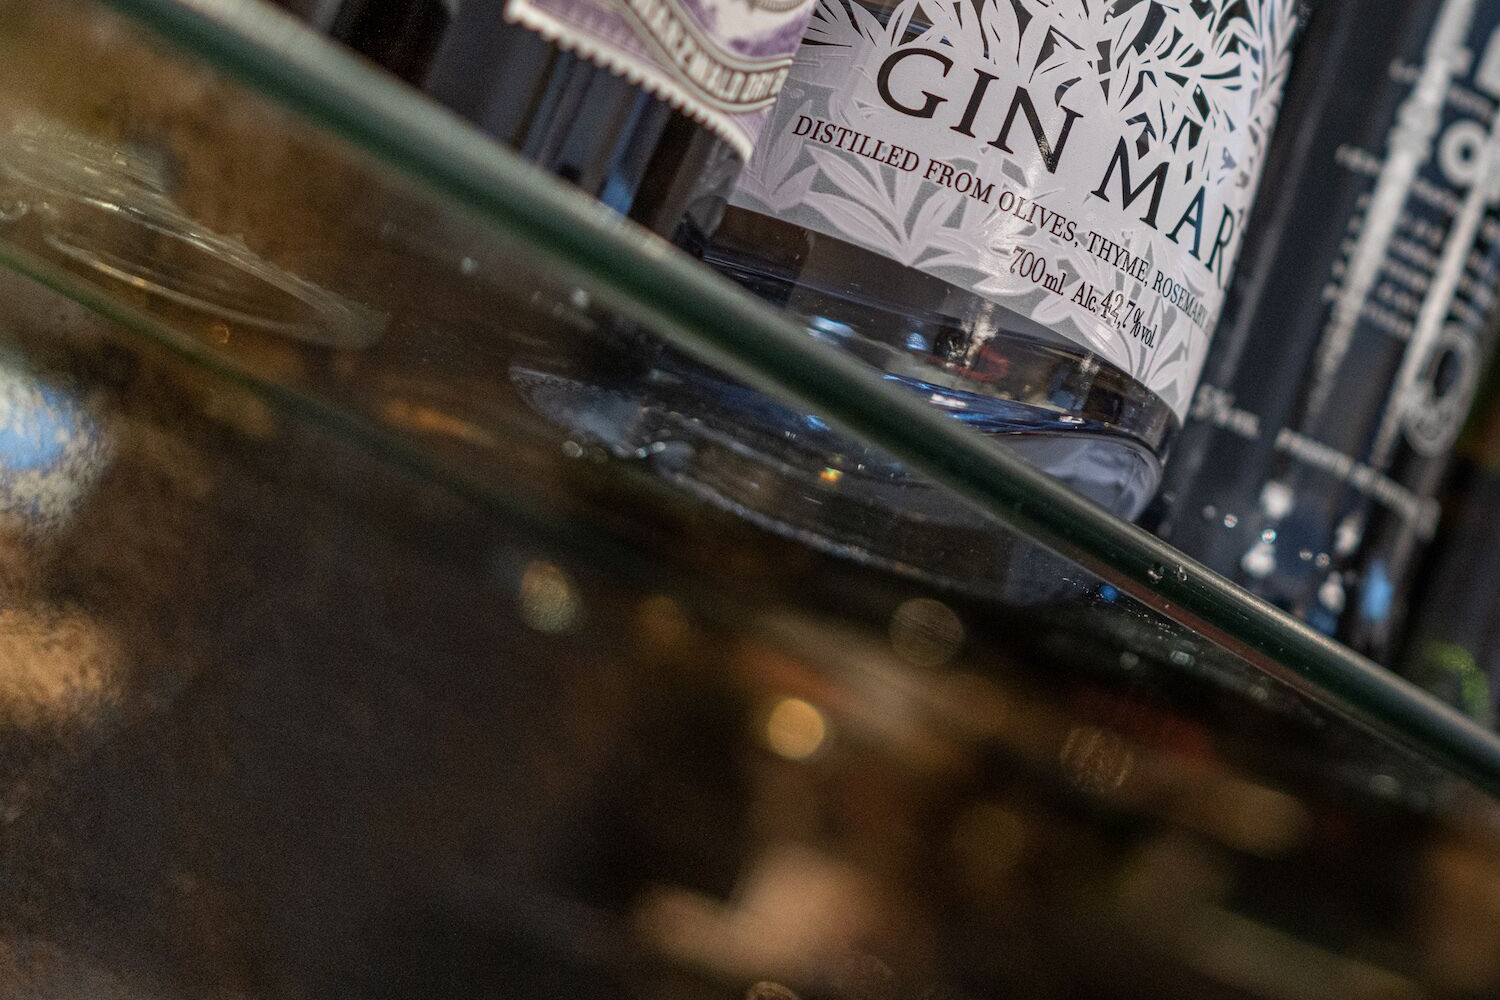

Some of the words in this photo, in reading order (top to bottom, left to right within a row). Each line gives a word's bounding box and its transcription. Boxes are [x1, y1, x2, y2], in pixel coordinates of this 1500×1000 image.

[876, 47, 1083, 174] GIN
[792, 114, 920, 173] DISTILLED
[922, 160, 998, 206] FROM
[998, 190, 1079, 247] OLIVES,
[1086, 230, 1149, 288] THYME,
[1070, 280, 1098, 314] Alc.
